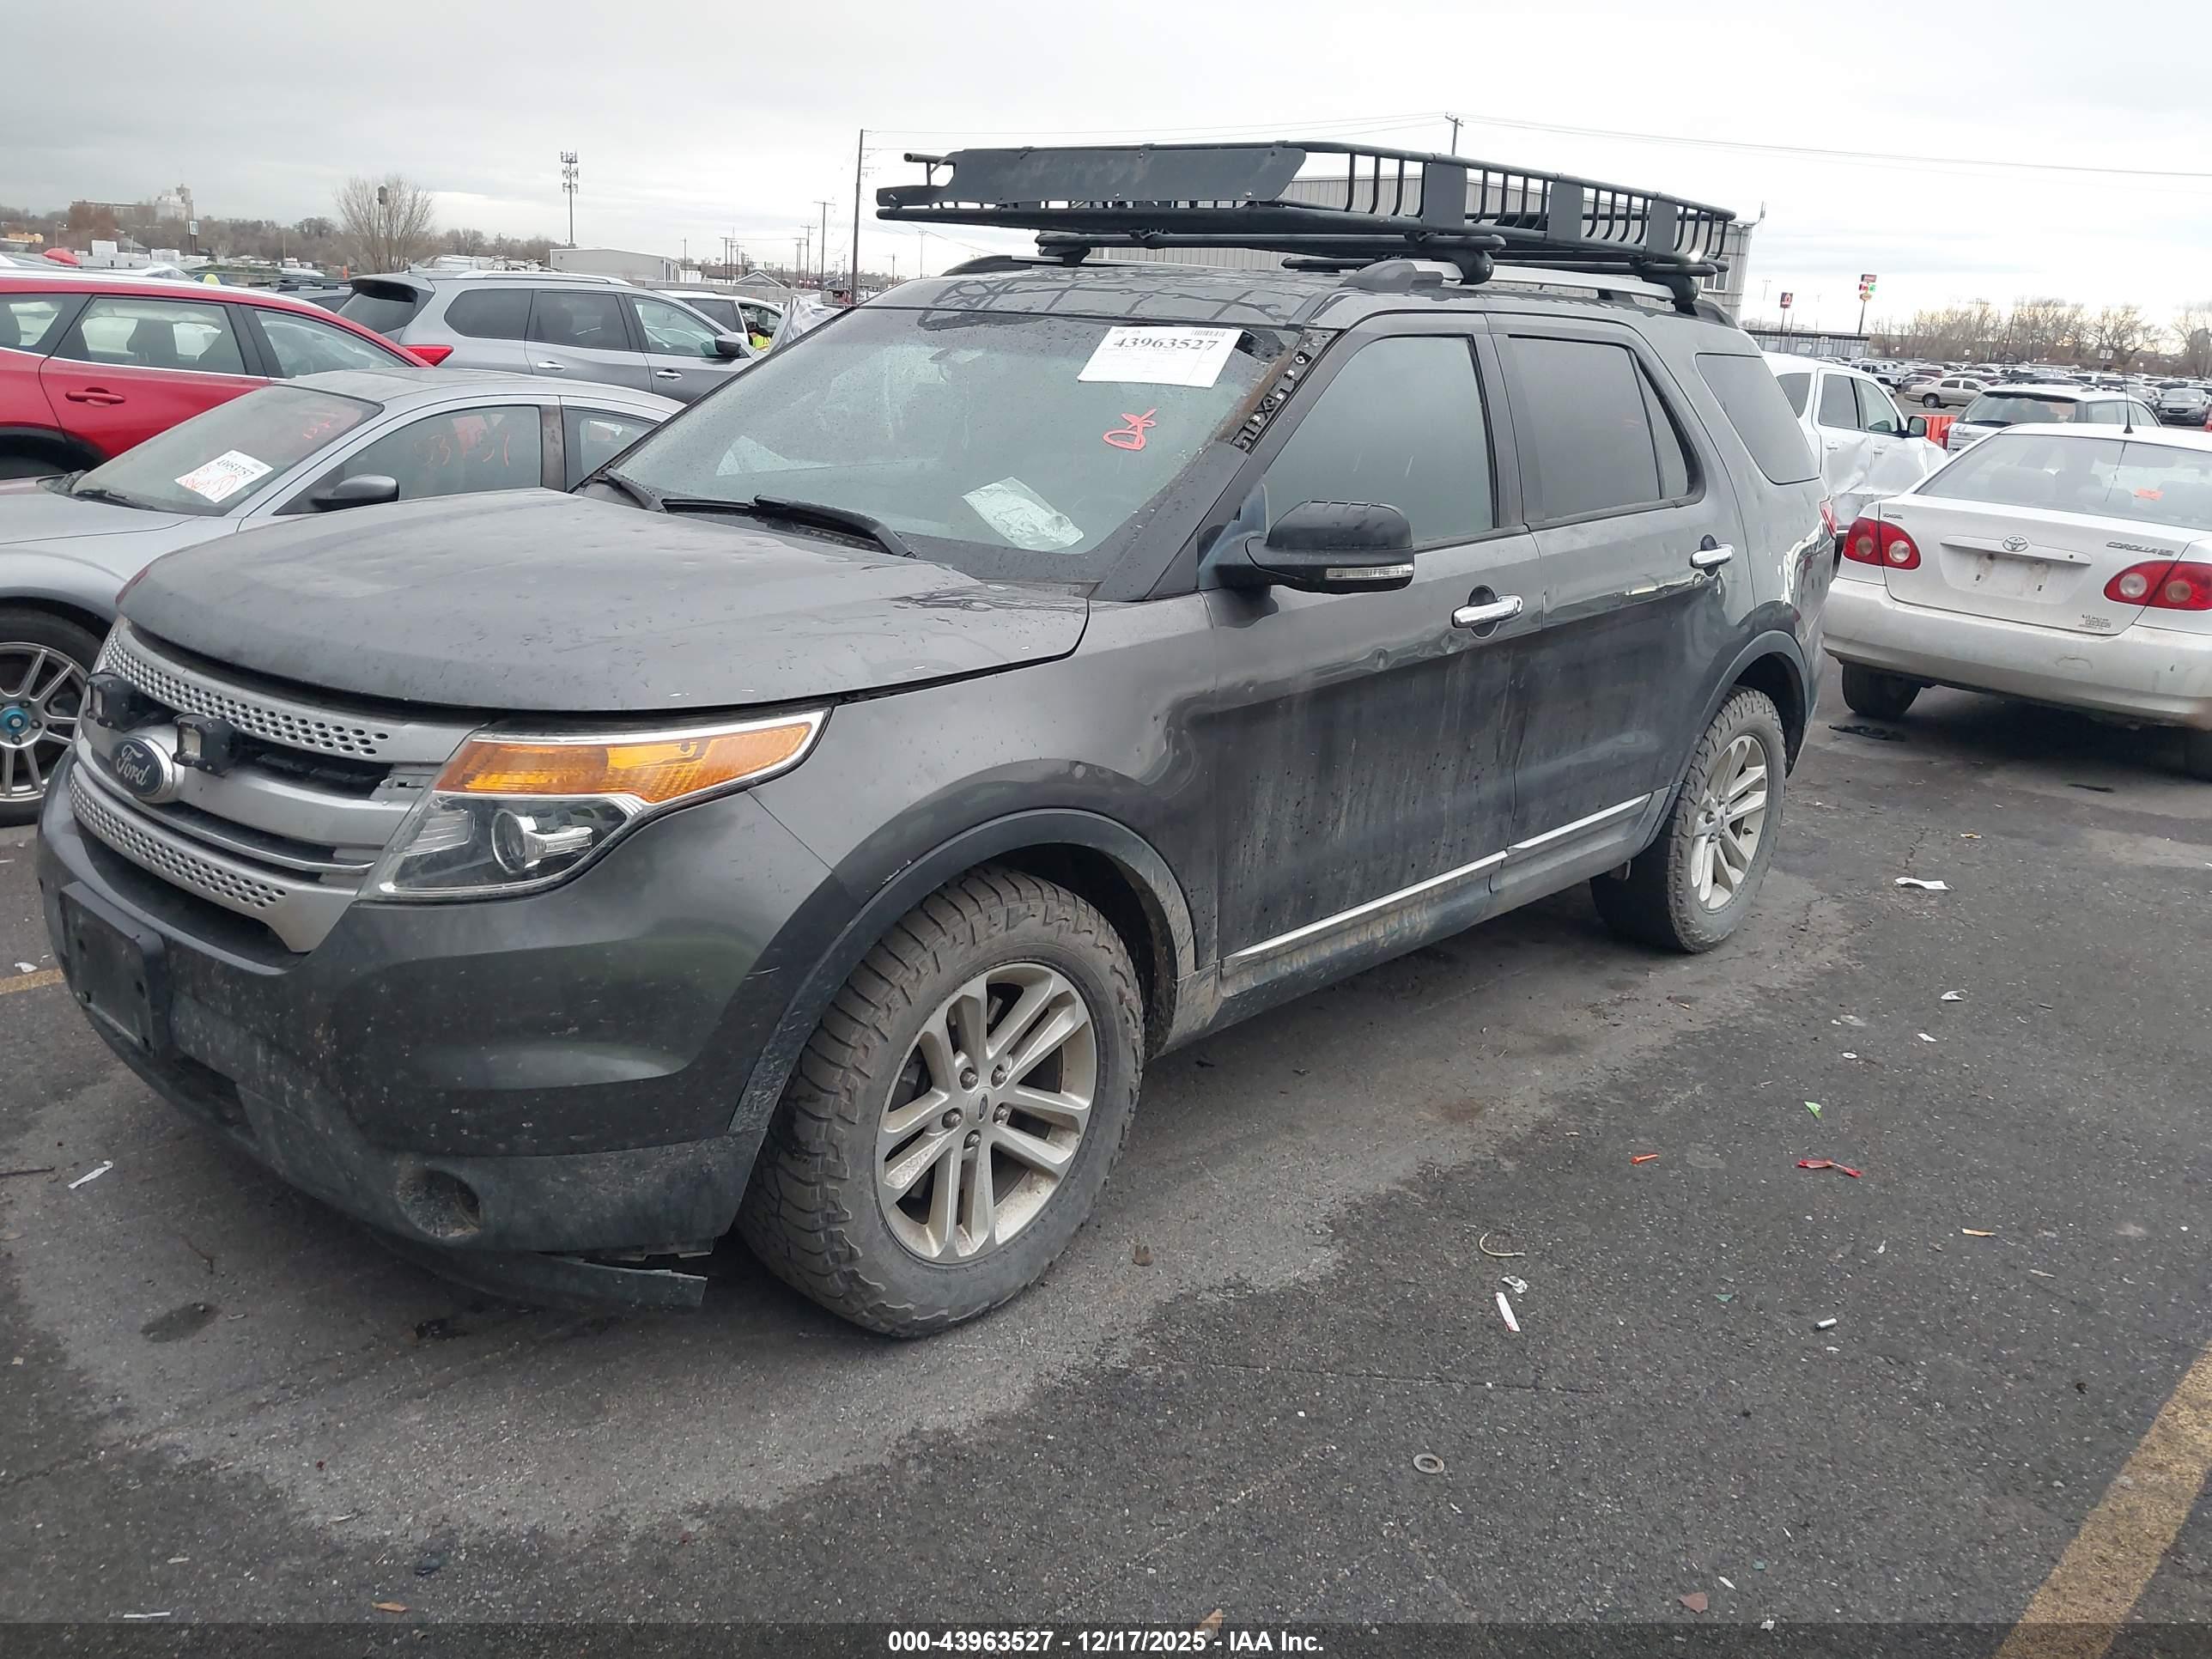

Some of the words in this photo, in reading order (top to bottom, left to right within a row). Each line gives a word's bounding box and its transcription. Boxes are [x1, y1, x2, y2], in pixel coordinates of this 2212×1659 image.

[1114, 337, 1219, 351] 43963527
[2106, 541, 2157, 555] COROLLA
[116, 744, 151, 786] Ford
